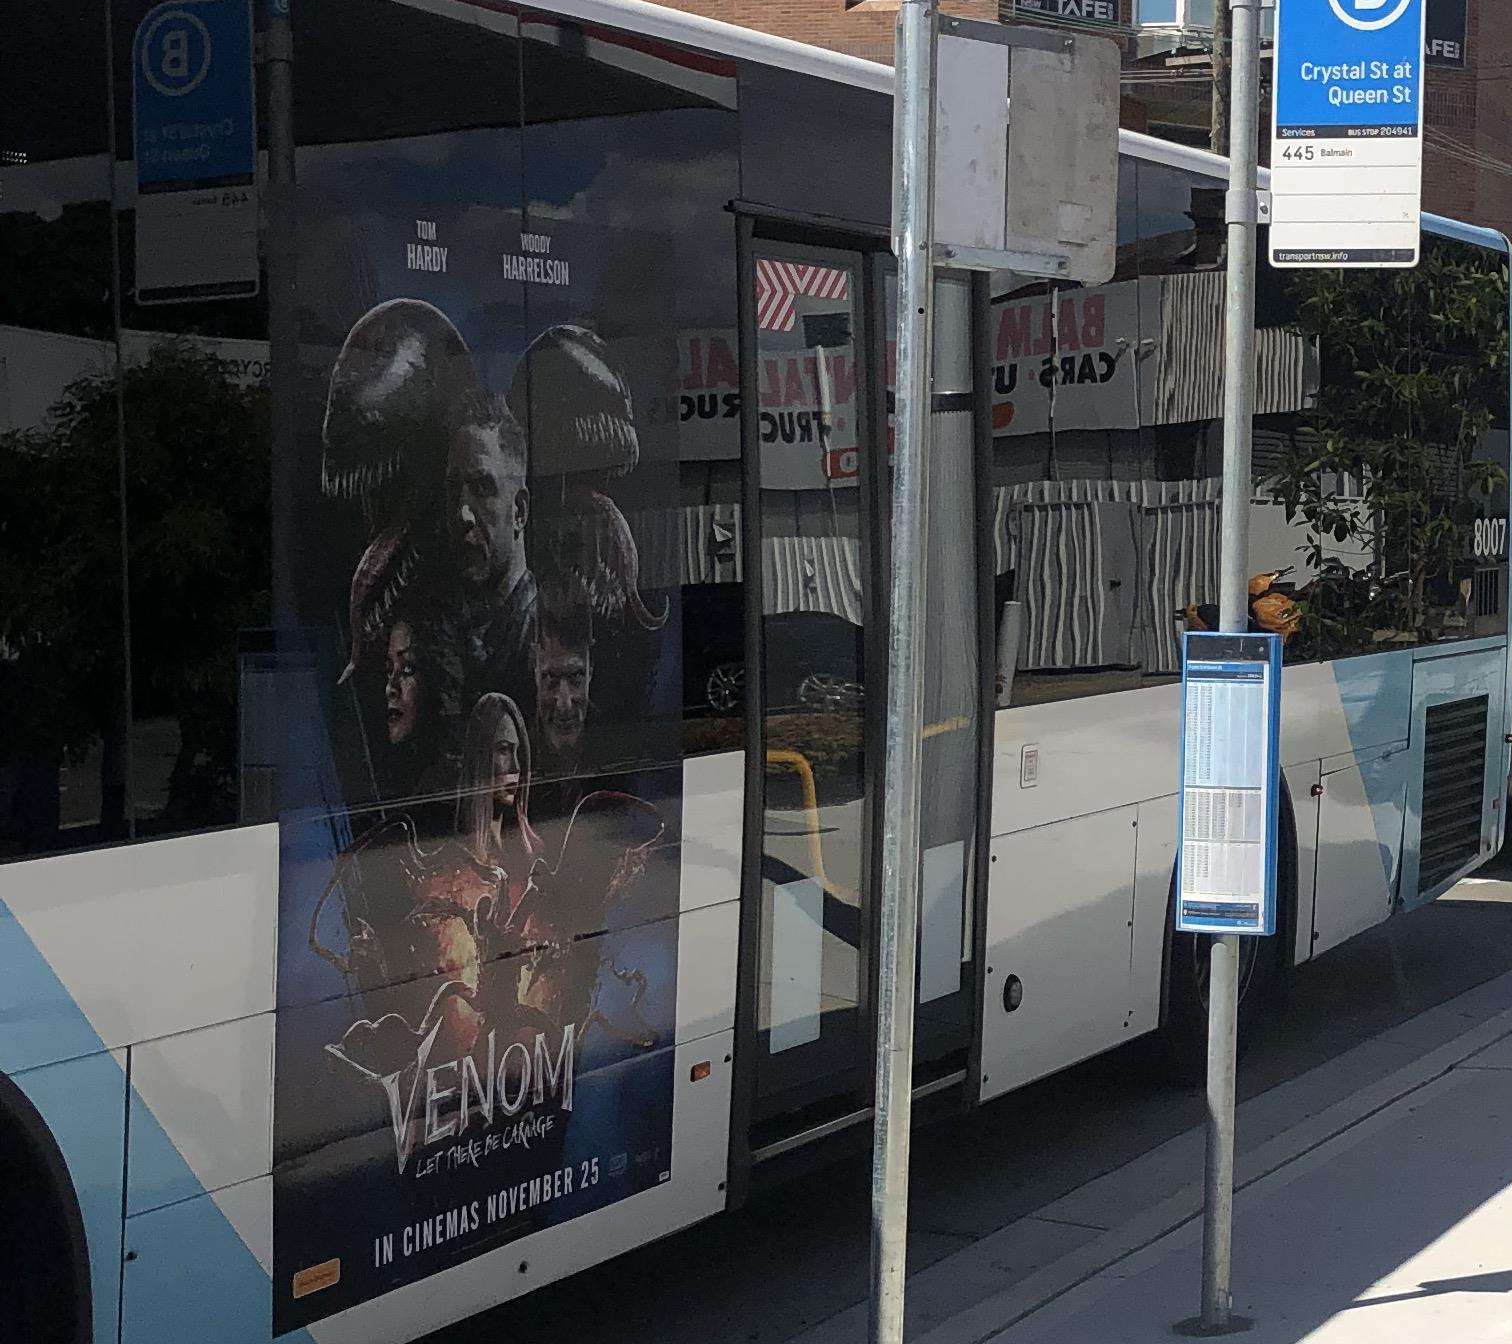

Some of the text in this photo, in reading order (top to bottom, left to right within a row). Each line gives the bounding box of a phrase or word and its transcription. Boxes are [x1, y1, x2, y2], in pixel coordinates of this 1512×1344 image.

[1301, 61, 1412, 85] Crystal St at
[1328, 85, 1411, 107] Queen St
[1282, 128, 1316, 137] Services
[1380, 127, 1412, 136] 204941
[1282, 146, 1353, 161] 445 Balmain
[416, 219, 436, 241] TOM
[520, 233, 551, 254] WOODY
[407, 243, 448, 273] HARDY
[1279, 252, 1349, 261] transportnsw.info
[503, 254, 569, 286] HARRELSON
[1473, 518, 1507, 557] 8007
[381, 1016, 574, 1174] VENOM
[415, 1115, 556, 1178] LET THERE BE CARNAGE
[375, 1237, 393, 1268] IN
[403, 1201, 480, 1257] CINEMAS
[487, 1166, 573, 1224] NOVEMBER
[580, 1157, 599, 1189] 25
